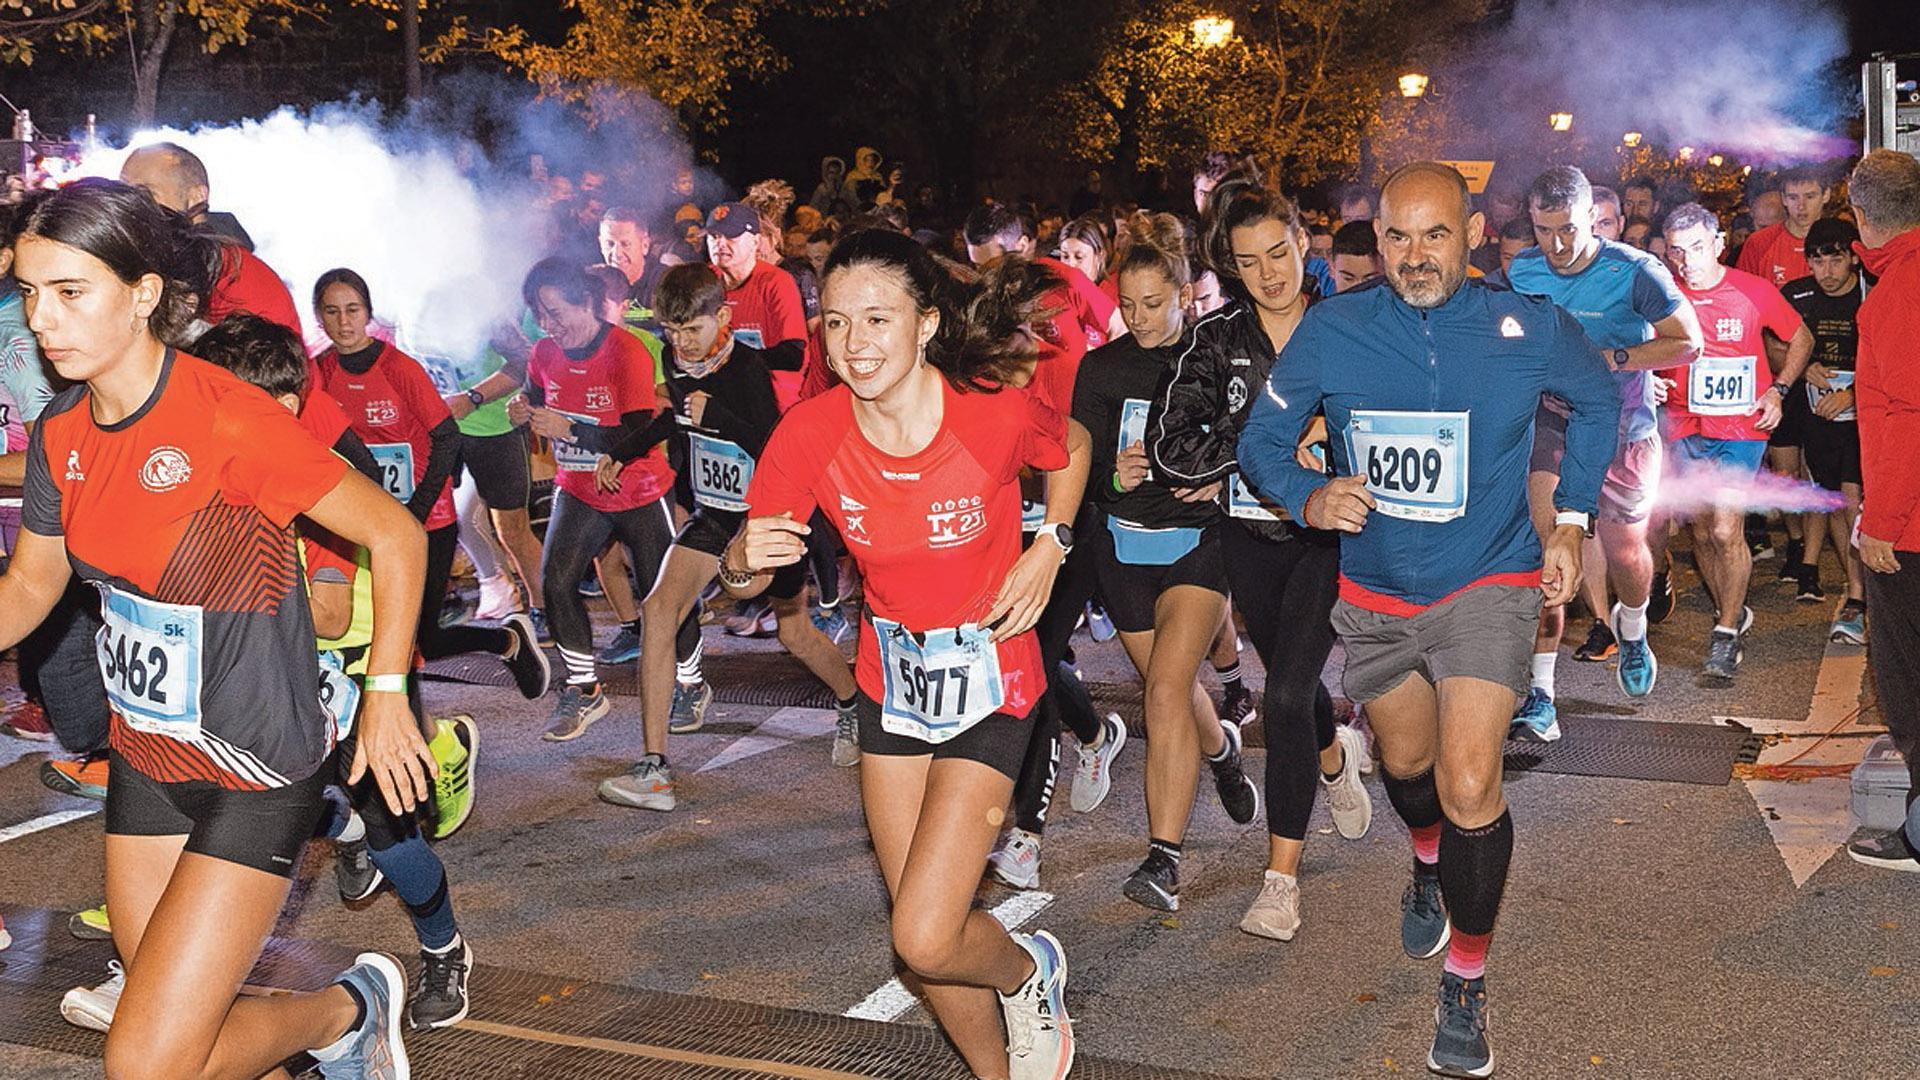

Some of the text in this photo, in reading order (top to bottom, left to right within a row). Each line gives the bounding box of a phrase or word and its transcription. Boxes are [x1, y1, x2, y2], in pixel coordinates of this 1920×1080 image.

[1704, 375, 1743, 400] 5491
[1438, 429, 1455, 440] 5k
[701, 457, 742, 495] 5862
[1367, 445, 1442, 493] 6209
[164, 623, 185, 637] 5k
[103, 623, 168, 705] 5462
[899, 657, 970, 717] 5977
[1036, 738, 1061, 821] NIKE
